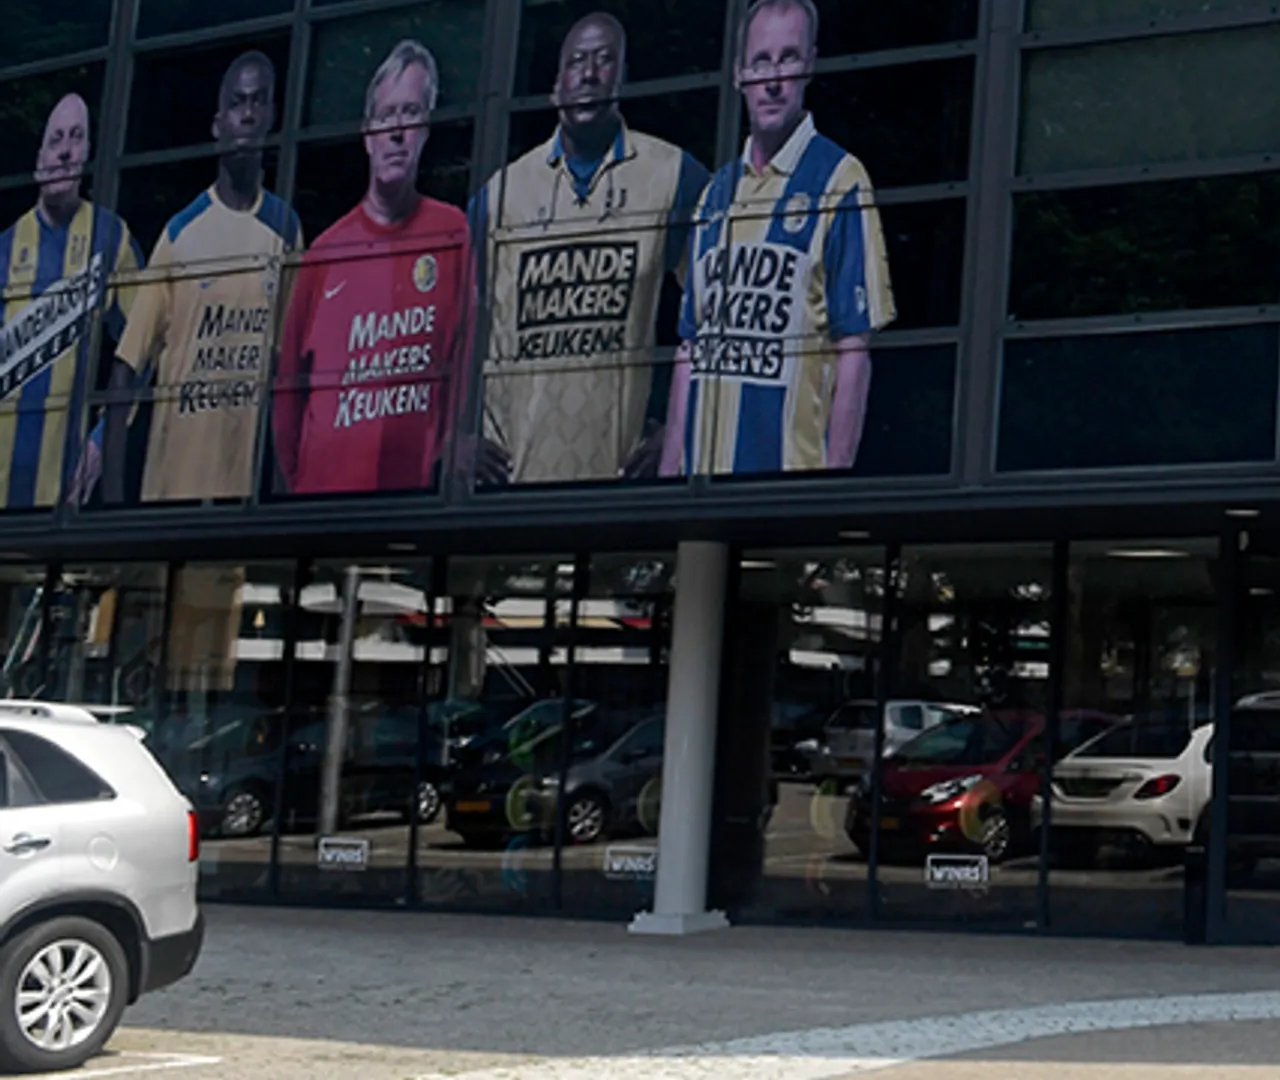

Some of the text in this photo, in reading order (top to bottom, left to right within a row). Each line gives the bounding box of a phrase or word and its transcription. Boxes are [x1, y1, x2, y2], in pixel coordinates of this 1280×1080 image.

[521, 247, 635, 289] MANDE
[520, 283, 629, 323] MAKERS
[701, 290, 794, 334] AKERS
[348, 304, 437, 353] MANDE
[513, 323, 626, 362] KEUKENS
[192, 345, 260, 373] MAKER
[342, 343, 432, 386] MAKERS
[333, 383, 431, 428] KEUKENS
